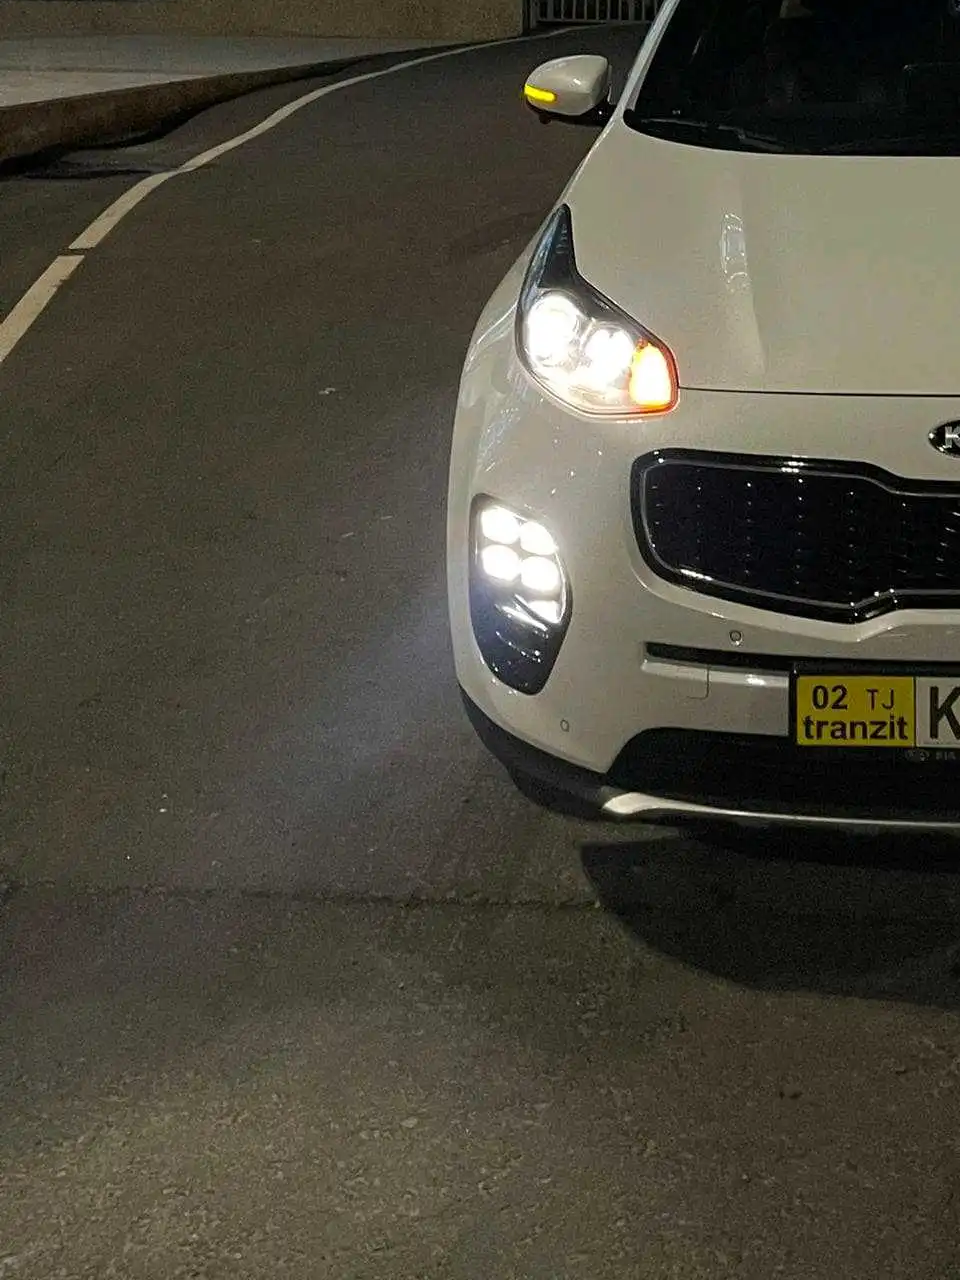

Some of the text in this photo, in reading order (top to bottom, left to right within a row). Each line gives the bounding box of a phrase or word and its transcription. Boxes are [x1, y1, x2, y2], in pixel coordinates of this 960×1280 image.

[812, 685, 895, 710] 02 TJ
[803, 715, 908, 740] tranzit
